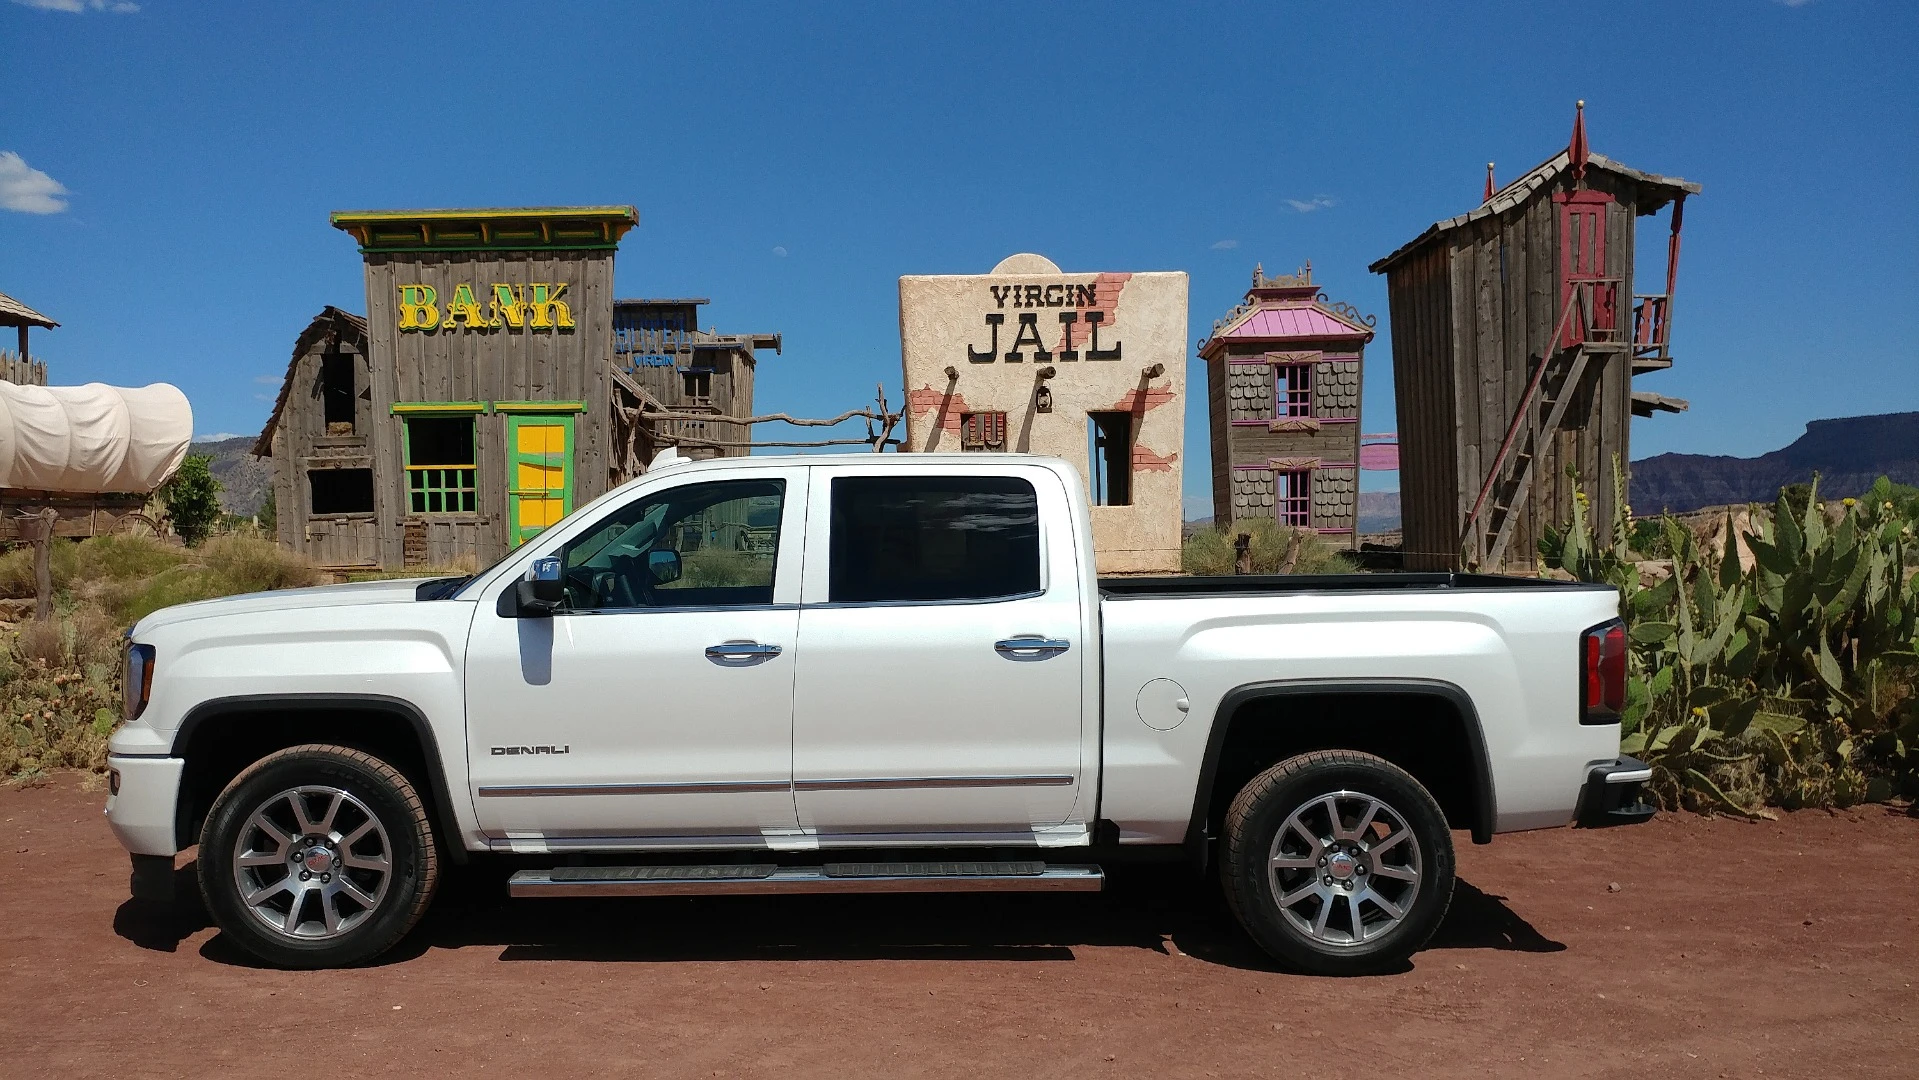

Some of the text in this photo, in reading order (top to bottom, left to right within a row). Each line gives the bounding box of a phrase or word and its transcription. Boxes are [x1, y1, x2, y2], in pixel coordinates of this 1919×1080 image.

[398, 283, 576, 331] BANK
[990, 284, 1097, 308] VIRGIN
[968, 311, 1121, 364] JAIL
[490, 744, 570, 756] DENALI
